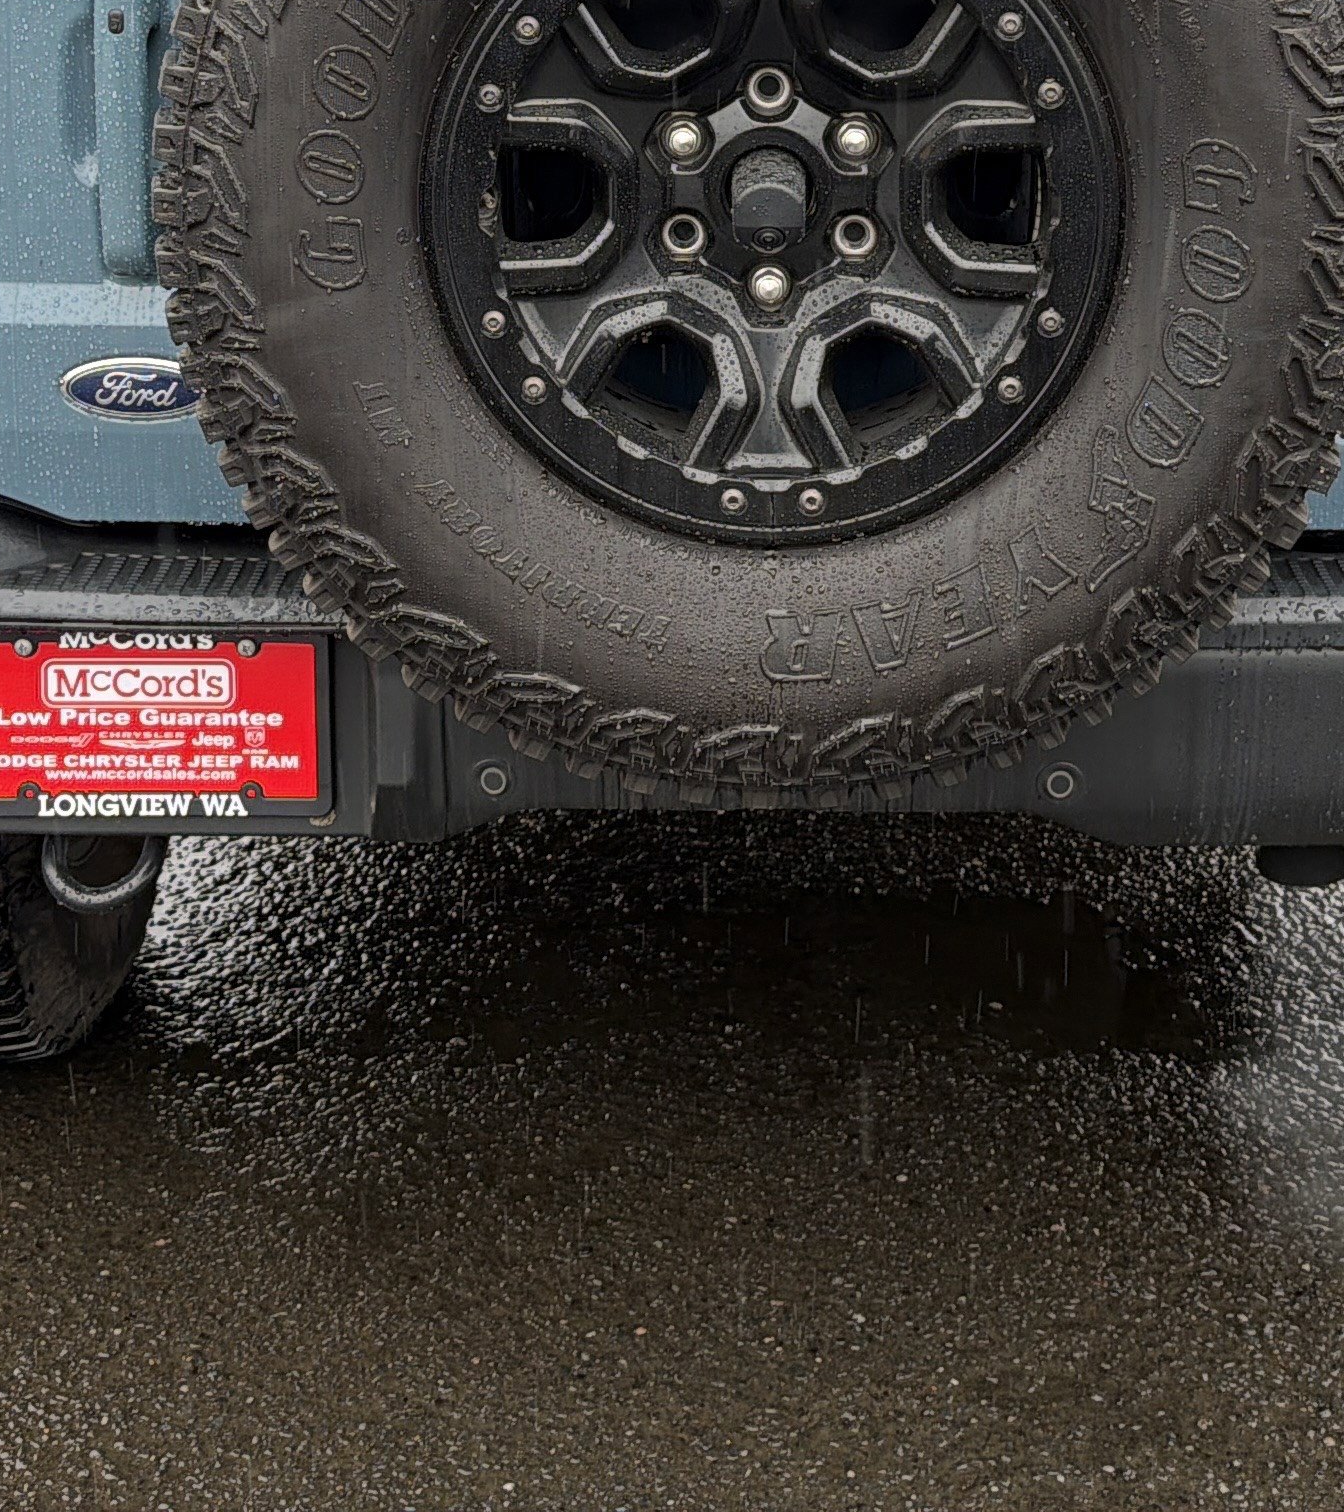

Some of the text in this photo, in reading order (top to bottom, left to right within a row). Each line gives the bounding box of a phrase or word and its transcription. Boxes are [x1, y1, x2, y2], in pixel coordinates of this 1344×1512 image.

[95, 371, 178, 407] Ford
[53, 668, 224, 698] McCord's
[60, 708, 132, 727] Price
[139, 708, 284, 727] Guarantee
[99, 731, 186, 739] CHRYSLER
[192, 731, 234, 748] Jeep
[64, 754, 181, 768] CHRYSLER
[187, 754, 244, 768] JEEP
[250, 754, 299, 769] RAM
[45, 768, 236, 781] www.mccordsales.com
[37, 794, 248, 817] LONGVIEW WA
